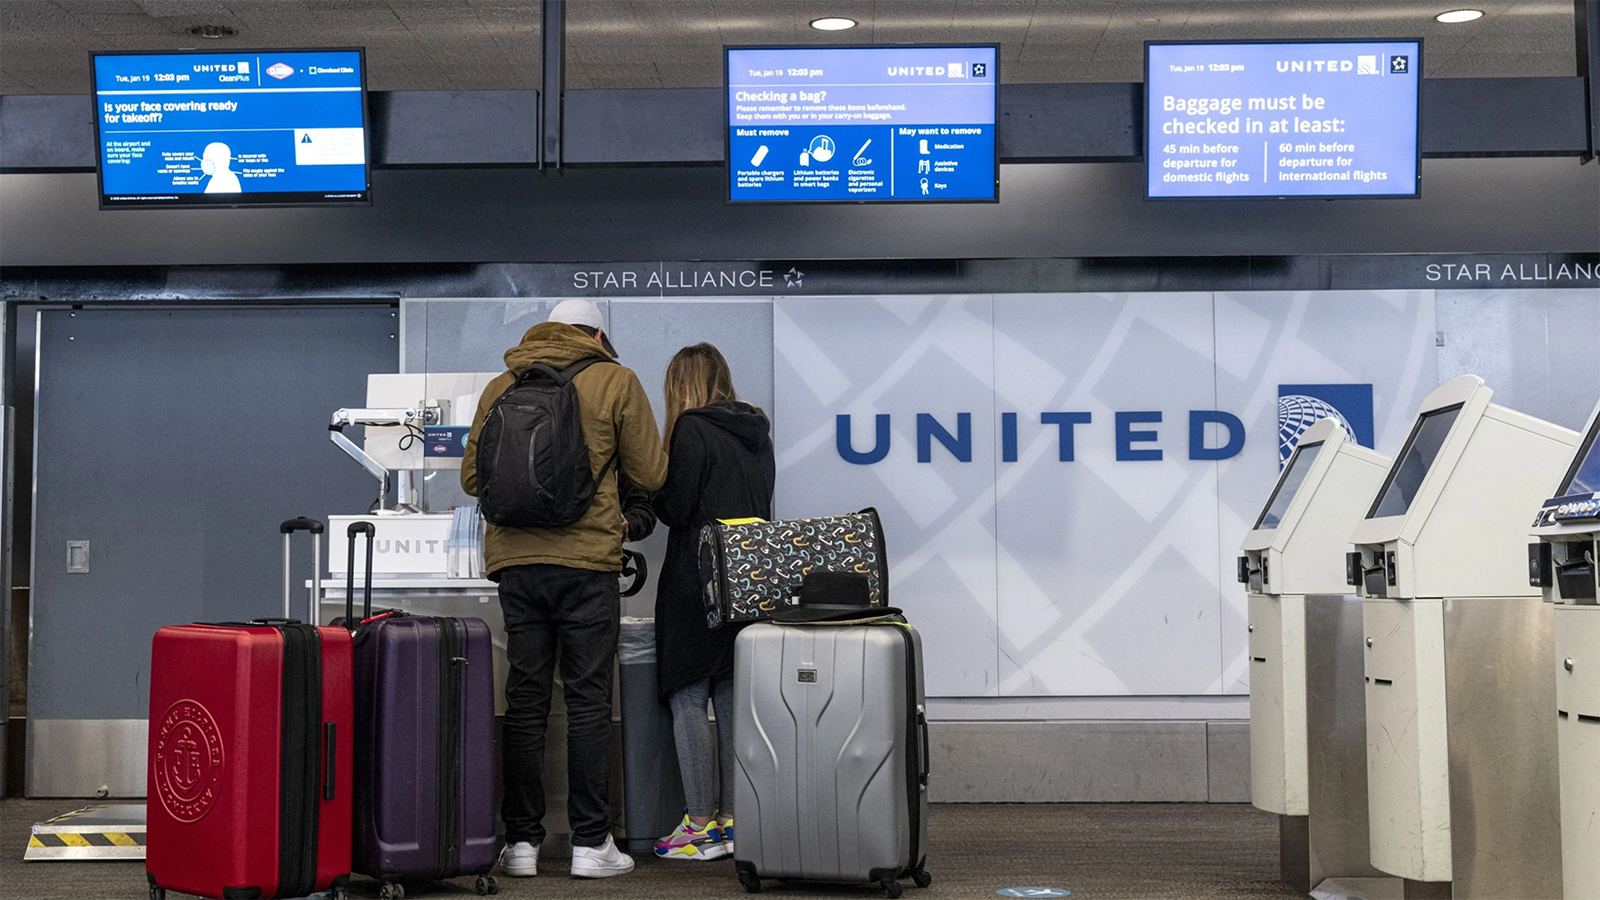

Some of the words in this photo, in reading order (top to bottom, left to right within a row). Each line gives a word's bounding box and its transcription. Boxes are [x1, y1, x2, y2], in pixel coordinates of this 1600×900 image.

[193, 64, 236, 73] UNITED
[887, 66, 945, 77] UNITED
[1183, 65, 1195, 73] Jan
[1208, 64, 1230, 72] 12:03
[1230, 64, 1245, 73] pm
[1276, 60, 1353, 73] UNITED
[153, 74, 176, 82] 12:03
[175, 74, 190, 83] pm
[218, 74, 250, 82] CleanPlus
[748, 69, 763, 77] Tue,
[763, 69, 774, 78] Jan
[775, 69, 784, 77] 19
[787, 68, 809, 77] 12:03
[809, 69, 824, 78] pm
[735, 91, 788, 104] Checking
[789, 92, 797, 102] a
[799, 90, 827, 104] bag?
[104, 102, 114, 112] Is
[114, 103, 140, 113] your
[140, 101, 162, 111] face
[162, 101, 207, 112] covering
[207, 100, 238, 112] ready
[866, 103, 907, 111] beforehand.
[1163, 95, 1242, 115] Baggage
[1248, 95, 1297, 111] must
[1302, 93, 1326, 110] be
[104, 114, 121, 123] for
[121, 112, 163, 123] takeoff?
[736, 113, 753, 121] Keep
[834, 112, 862, 120] carry-on
[862, 111, 893, 120] baggage.
[1162, 117, 1240, 134] checked
[1245, 117, 1264, 133] in
[1269, 118, 1289, 133] at
[1294, 116, 1345, 133] least:
[736, 129, 758, 137] Must
[758, 129, 790, 137] remove
[899, 127, 917, 137] May
[917, 127, 940, 135] want
[940, 127, 950, 135] to
[950, 127, 982, 135] remove
[1163, 144, 1177, 154] 45
[1179, 144, 1200, 154] min
[1203, 143, 1239, 153] before
[1279, 143, 1292, 153] 60
[1295, 142, 1316, 152] min
[1319, 141, 1355, 152] before
[1163, 158, 1218, 170] departure
[1220, 157, 1237, 167] for
[1279, 157, 1334, 168] departure
[1336, 156, 1353, 166] for
[1163, 172, 1213, 182] domestic
[1215, 171, 1250, 184] flights
[1279, 171, 1350, 181] international
[1353, 170, 1388, 183] flights
[859, 180, 884, 188] personal
[1425, 263, 1491, 281] STAR
[573, 271, 637, 289] STAR
[646, 270, 774, 289] ALLIANCE
[836, 409, 1246, 466] UNITED
